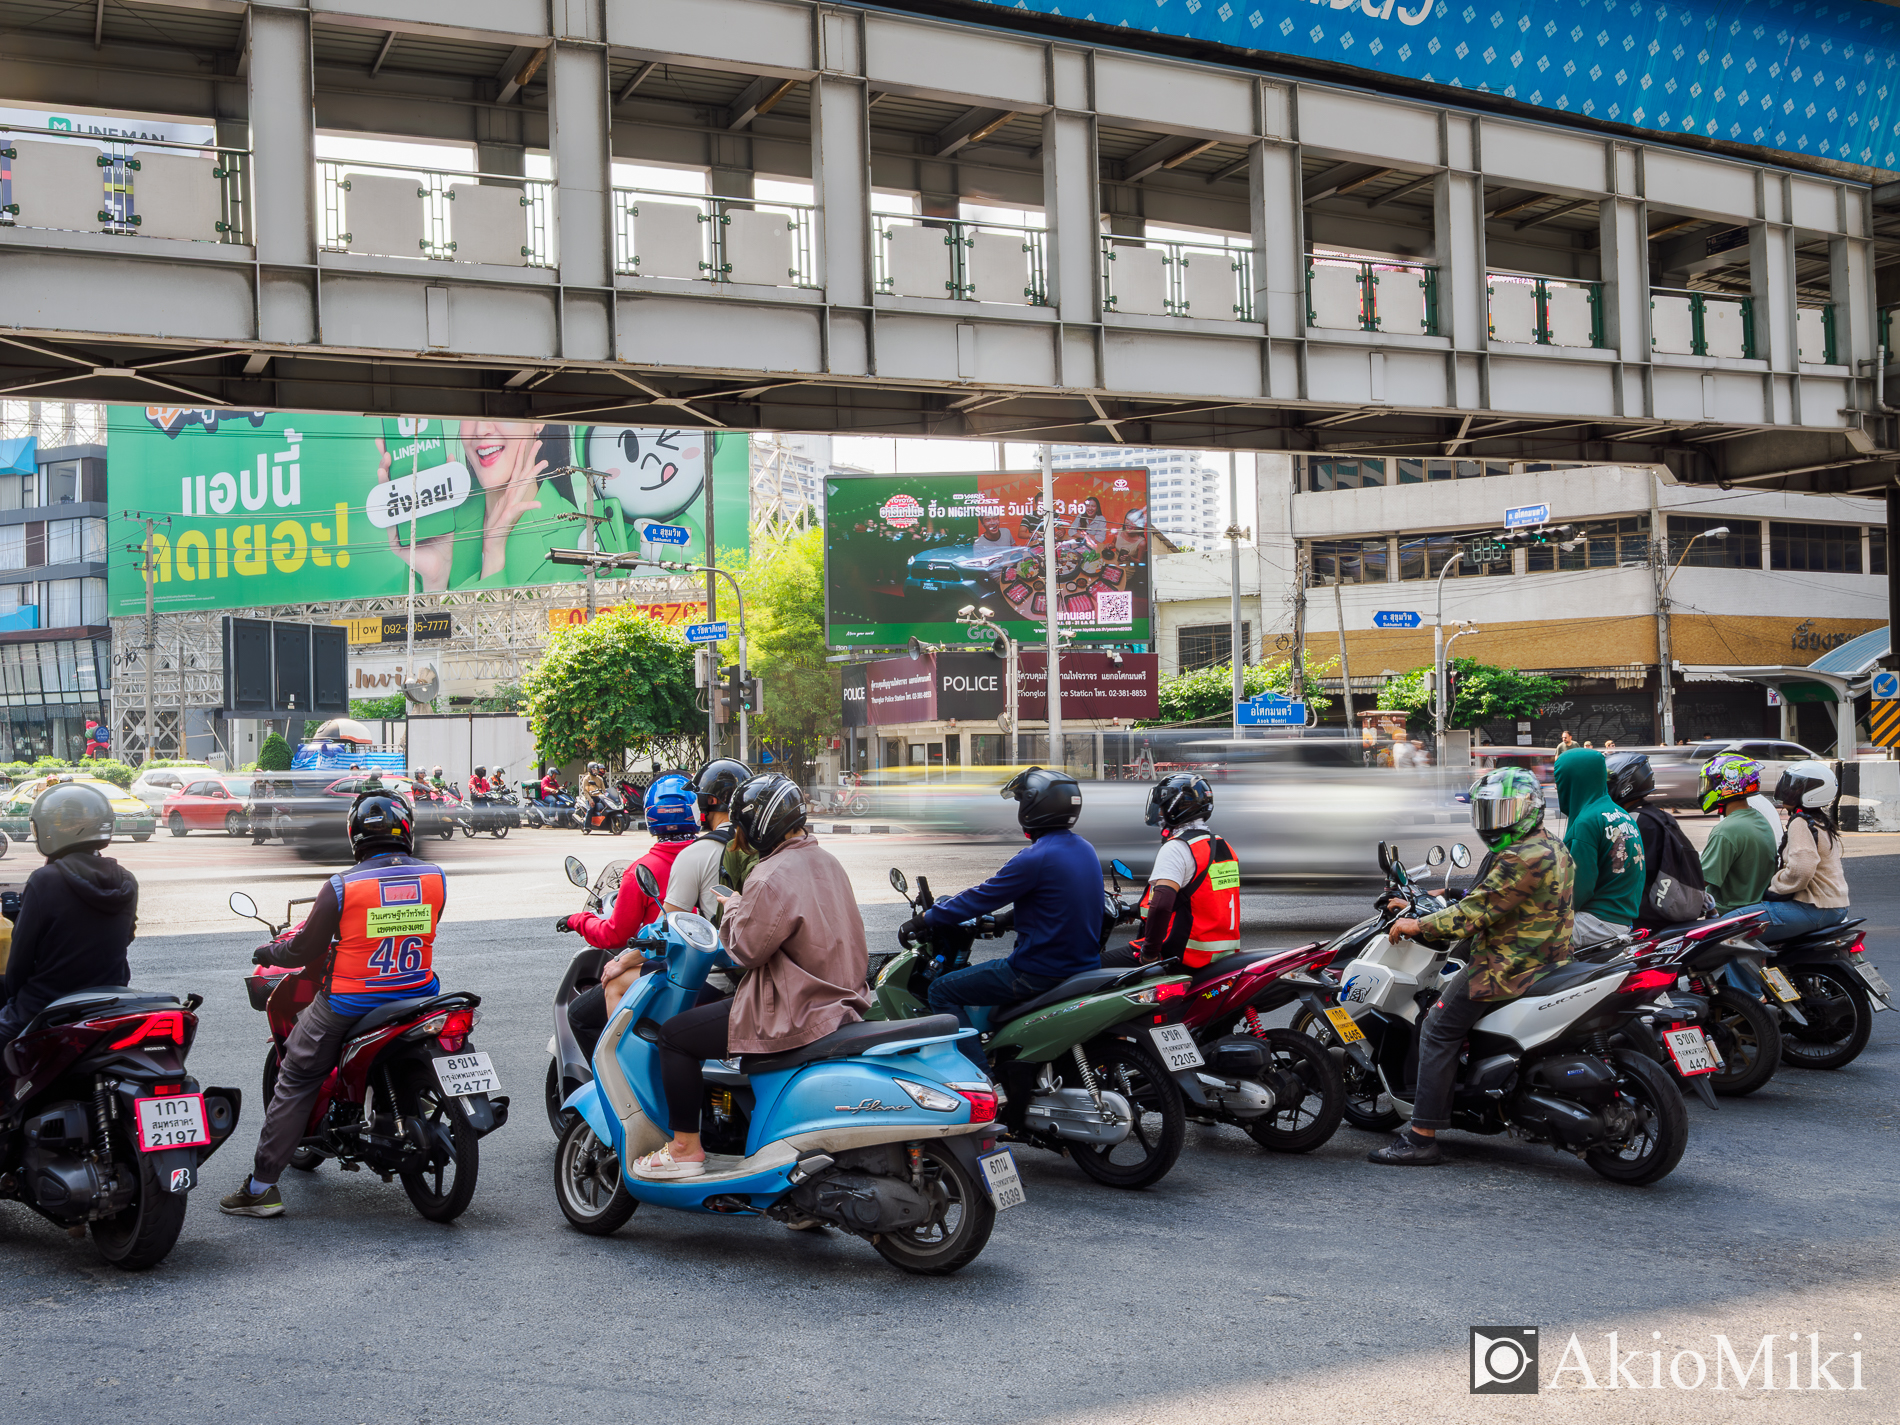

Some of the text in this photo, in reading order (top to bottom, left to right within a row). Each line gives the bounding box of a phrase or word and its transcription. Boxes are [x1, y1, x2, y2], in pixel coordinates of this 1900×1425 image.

[415, 436, 441, 456] MAN
[182, 428, 303, 517] แอปนี้
[386, 476, 454, 518] สั่งเลย!
[927, 499, 946, 518] ซื้อ
[1008, 497, 1034, 516] วันนี้
[1055, 499, 1066, 515] 3
[660, 528, 681, 538] สุขุมวิท
[141, 502, 351, 585] ลดเยอะ!
[1056, 611, 1096, 621] แกนเลย!
[1389, 612, 1413, 623] สุขุมวิท
[697, 624, 726, 634] รัชดาภิเษก
[967, 626, 1009, 640] Grab
[355, 666, 407, 689] Invi
[1101, 670, 1147, 681] แยกอโศกมนตรี
[943, 676, 998, 691] POLICE
[843, 687, 866, 701] POLICE
[1070, 689, 1093, 697] Station
[1094, 687, 1107, 697] โทร.
[1108, 689, 1147, 697] 02-381-8853
[1250, 703, 1292, 717] อโศกมนตรี
[1656, 877, 1672, 908] FILA
[1228, 893, 1236, 931] 1
[377, 923, 424, 934] เขตคลองเตย
[367, 936, 423, 976] 46
[1537, 992, 1582, 1011] CLICK
[447, 1056, 479, 1070] 8ขน
[1171, 1052, 1197, 1067] 2205
[1689, 1057, 1710, 1071] 442
[441, 1069, 493, 1082] กรุงเทพมหานคร
[453, 1079, 491, 1094] 2477
[155, 1100, 189, 1116] 1กว
[152, 1118, 194, 1131] สมุทรสาคร
[151, 1129, 197, 1147] 2197
[999, 1187, 1021, 1206] 6339
